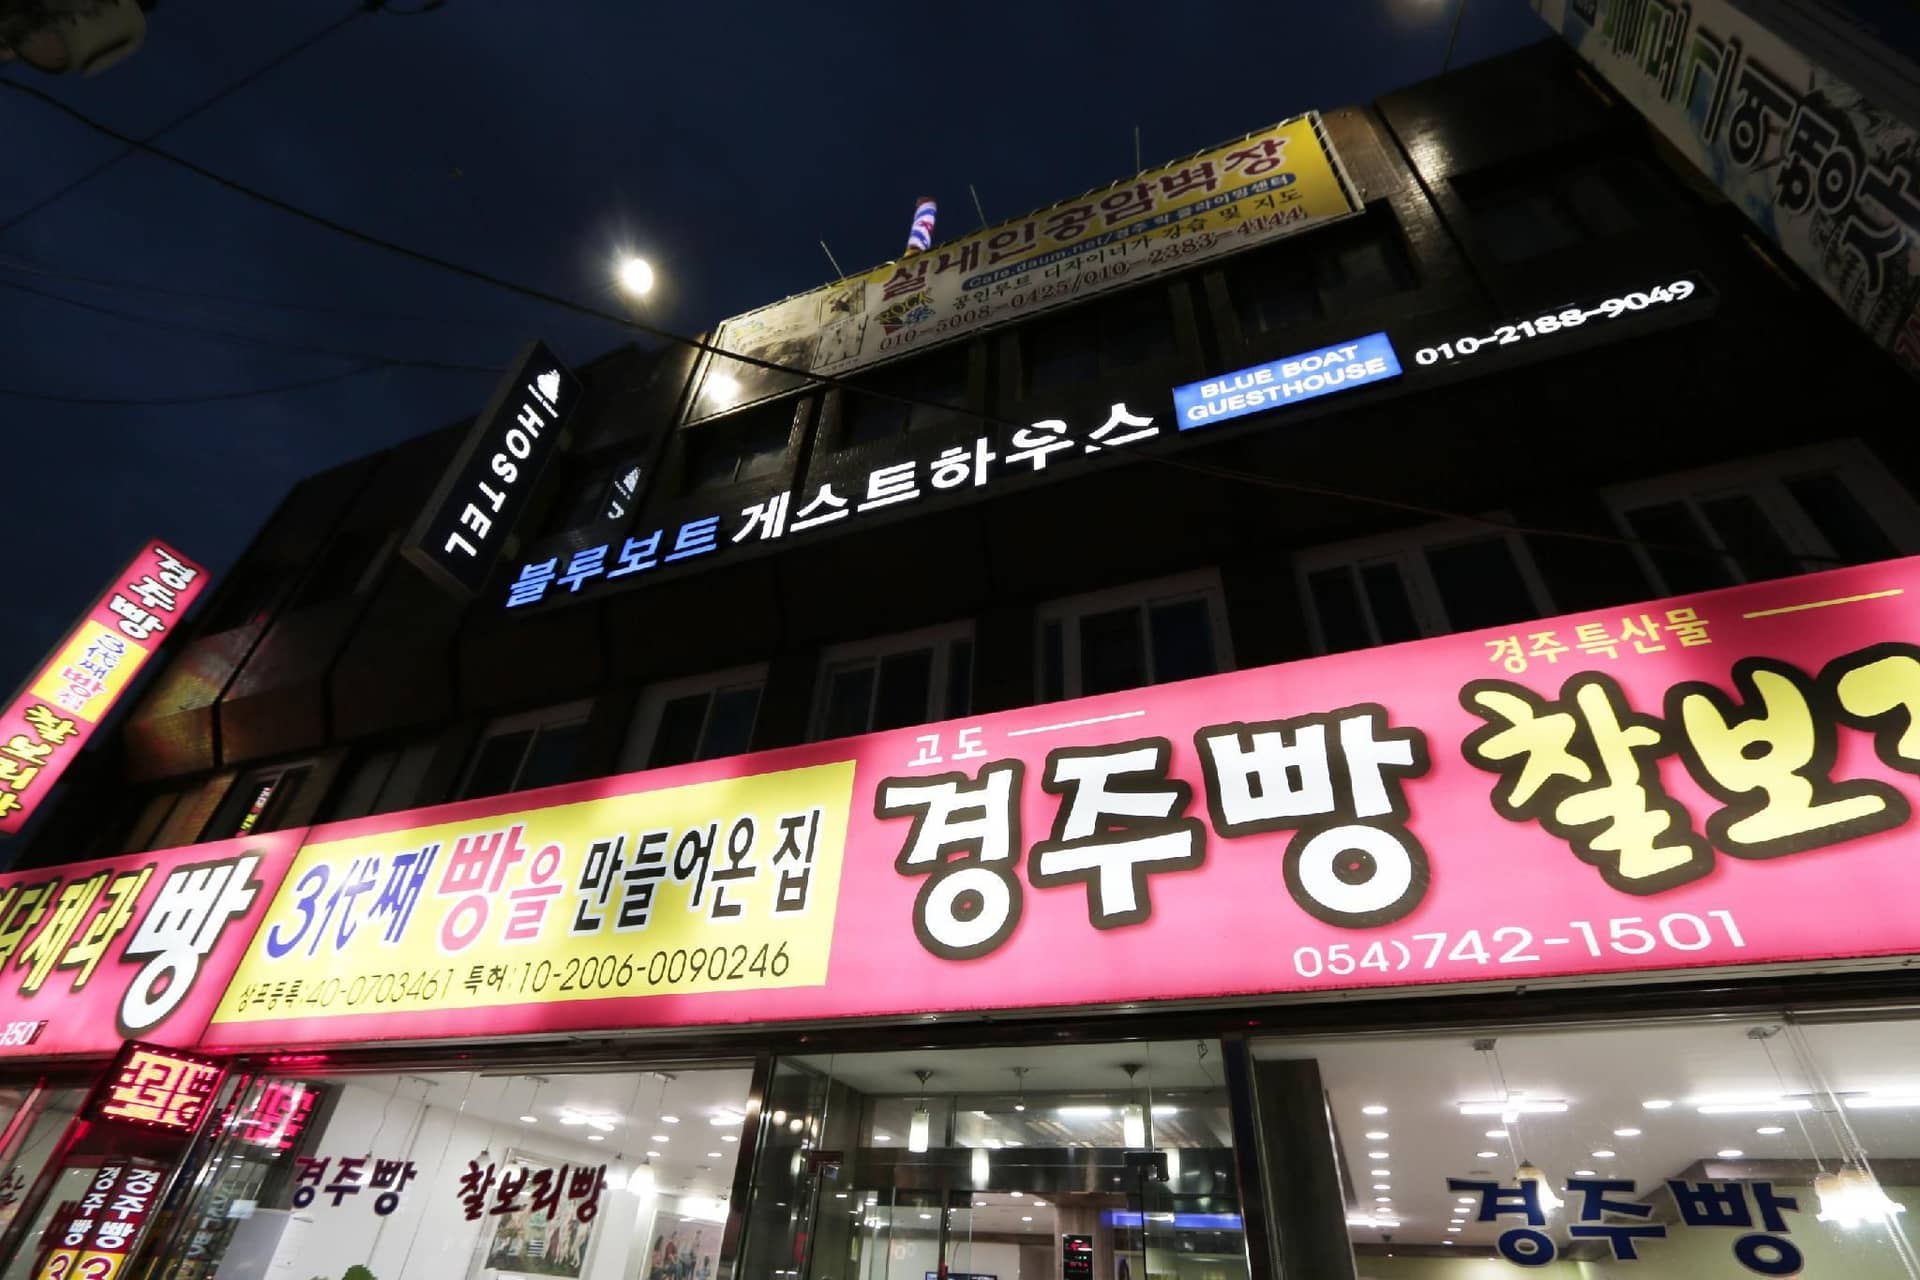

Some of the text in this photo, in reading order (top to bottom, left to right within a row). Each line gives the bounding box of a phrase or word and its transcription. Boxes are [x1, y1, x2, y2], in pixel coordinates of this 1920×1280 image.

[882, 138, 1286, 301] 실내인공암벽장
[1045, 235, 1152, 278] 디자이너가
[1415, 280, 1695, 365] 010-2188-9049
[1187, 357, 1388, 421] GUESTHOUSE
[1201, 345, 1358, 399] BLUE BOAT
[444, 403, 545, 557] HOSTEL
[506, 403, 1160, 607] 블루보트 게스트하우스
[109, 547, 197, 640] 경주빵
[1485, 607, 1713, 674] 경주 특산물
[907, 727, 988, 767] 고도
[883, 712, 1416, 950] 경주빵
[440, 826, 562, 951] 빵을
[572, 816, 758, 932] 만들어온
[773, 810, 821, 913] 집
[120, 853, 258, 1032] 빵
[1294, 909, 1747, 979] 054)742-1501
[64, 1167, 122, 1247] 경주빵
[96, 1168, 161, 1249] 경주빵
[294, 1155, 607, 1223] 경주빵 찰보리빵
[1447, 1177, 1799, 1277] 경주빵
